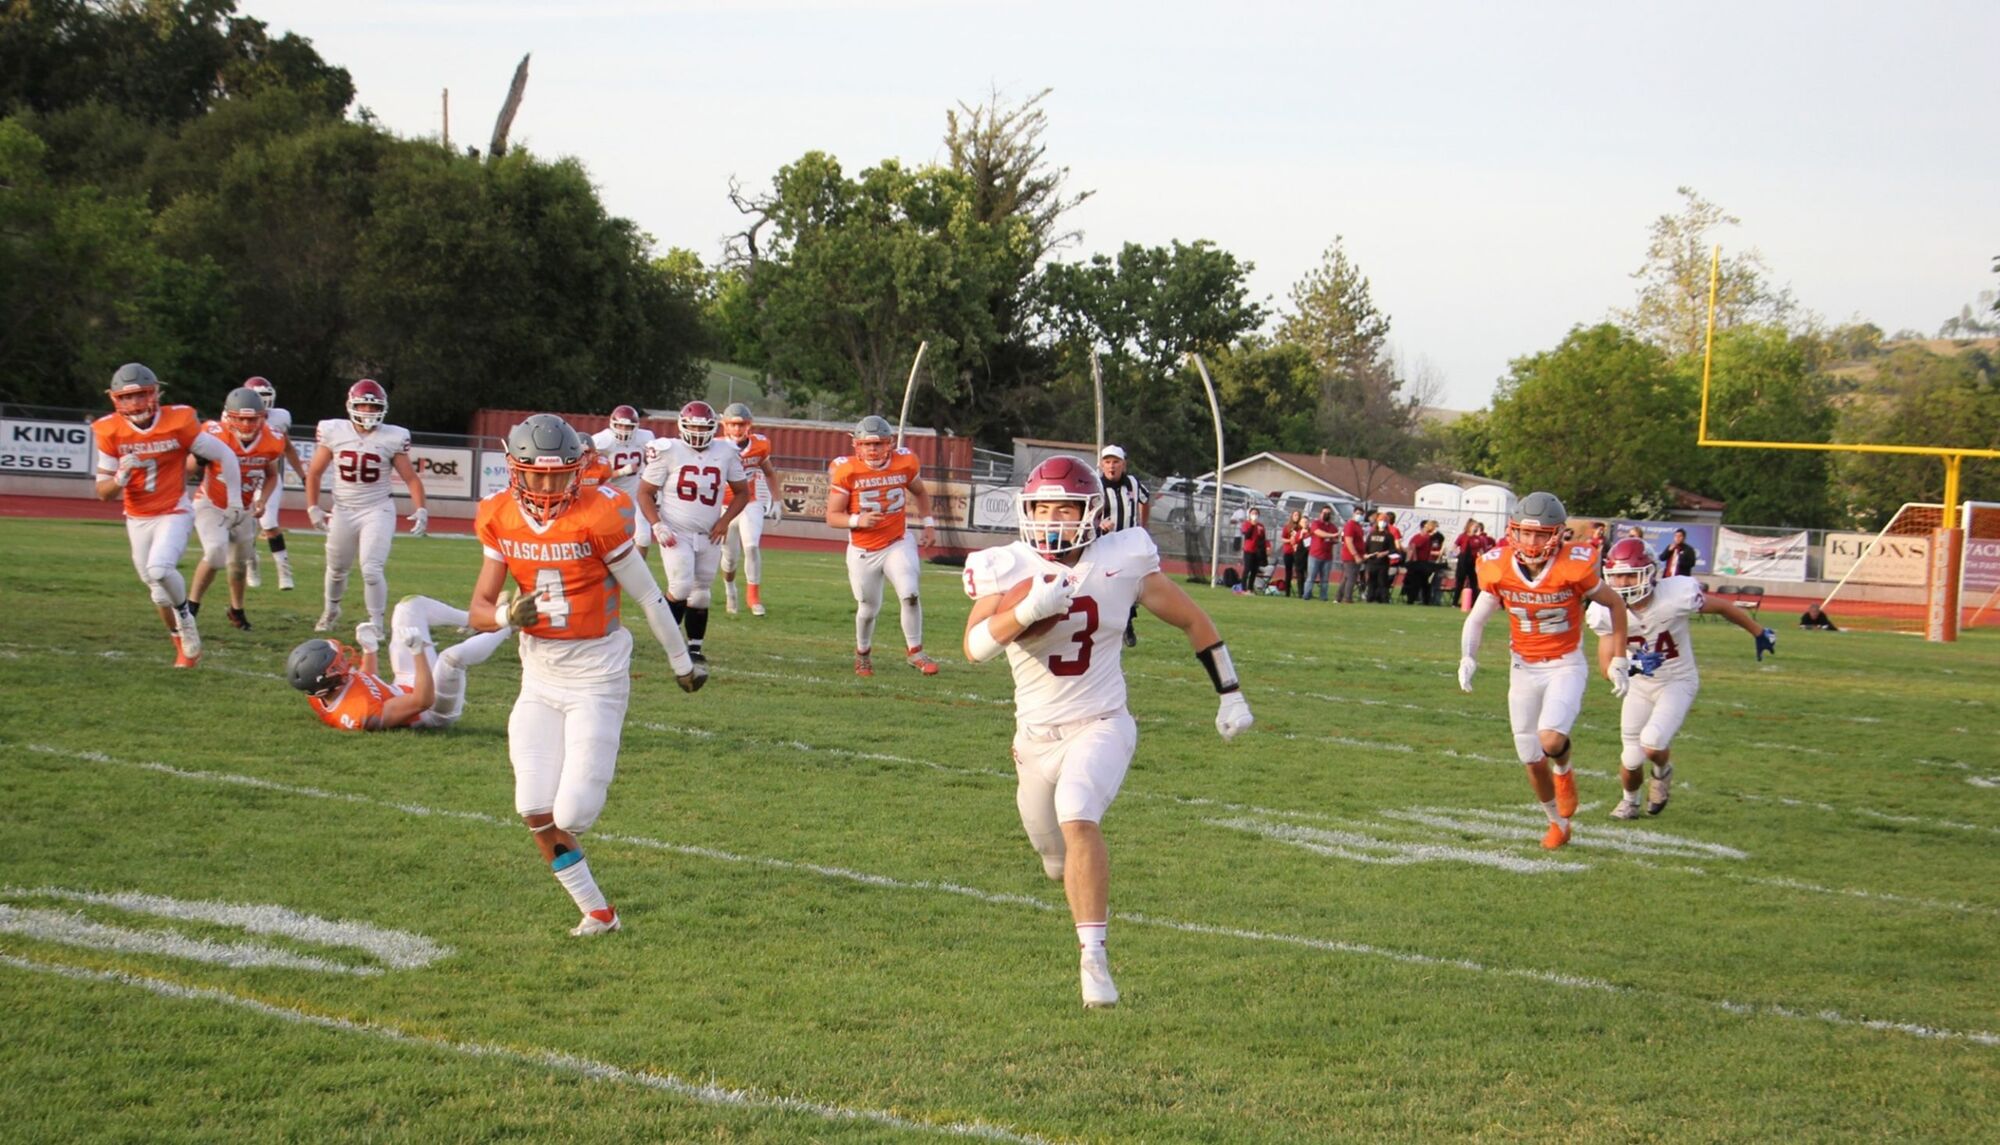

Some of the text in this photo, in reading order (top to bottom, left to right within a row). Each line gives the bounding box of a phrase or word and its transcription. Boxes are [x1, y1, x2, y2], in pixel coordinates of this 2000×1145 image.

[14, 425, 87, 444] KING
[1, 454, 71, 469] 2565
[339, 450, 381, 483] 26
[677, 465, 721, 506] 63
[859, 487, 905, 515] 52
[1569, 546, 1592, 561] 12
[965, 568, 977, 597] 3
[534, 568, 571, 629] 4
[1509, 607, 1570, 633] 12
[1048, 595, 1100, 676] 3
